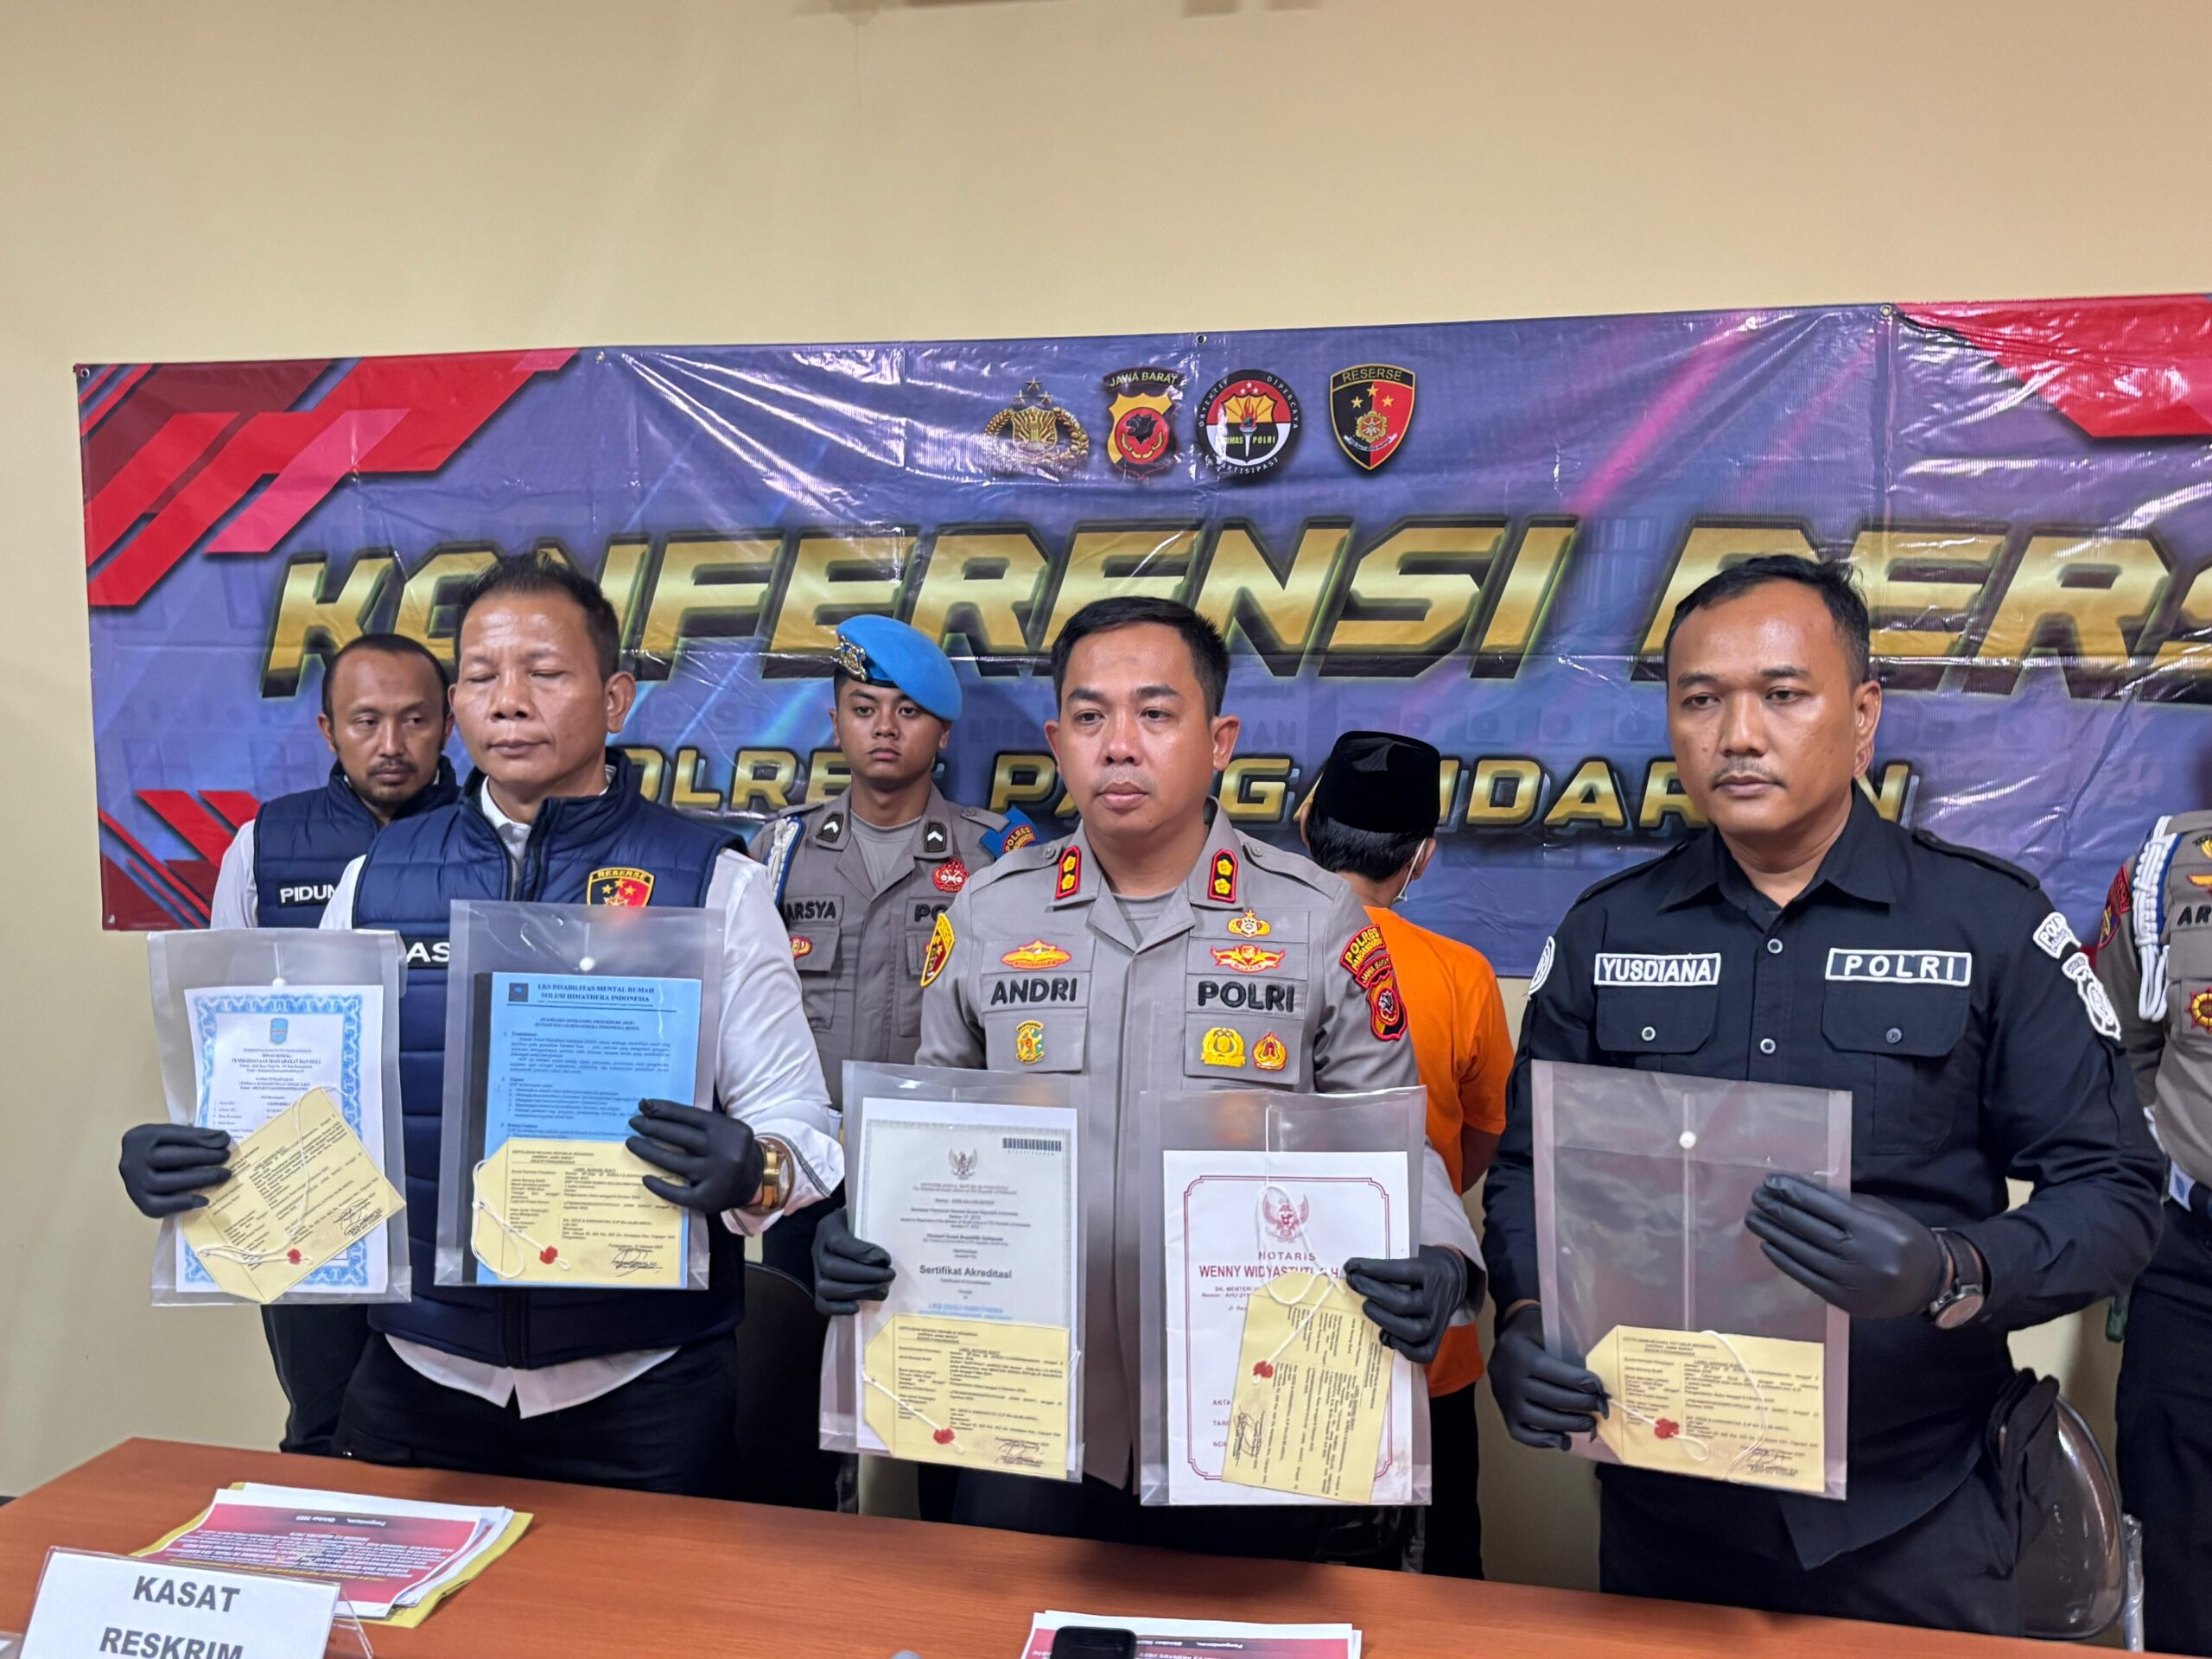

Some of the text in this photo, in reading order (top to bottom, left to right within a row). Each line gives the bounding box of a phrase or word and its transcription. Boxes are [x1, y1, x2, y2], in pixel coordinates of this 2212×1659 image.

[1110, 372, 1178, 386] JAWA BARAT
[1343, 368, 1402, 383] RESERSE
[1267, 376, 1299, 429] DIPERCAYA
[1253, 435, 1275, 444] POLRI
[1217, 456, 1279, 474] ARTISIPASI
[624, 747, 851, 810] OLRE
[598, 869, 647, 880] RESERSE
[1344, 927, 1379, 963] POLRES
[1602, 958, 1712, 983] YUSDIANA
[1843, 955, 1955, 980] POLRI
[990, 978, 1077, 1005] ANDRI
[1198, 980, 1294, 1013] POLRI
[1258, 1252, 1316, 1262] NOTARIS
[919, 1265, 1012, 1279] Sertifikat Akreditasi
[1199, 1265, 1241, 1277] WENNY
[133, 1576, 240, 1612] KASAT
[99, 1627, 244, 1659] RESKRIM
